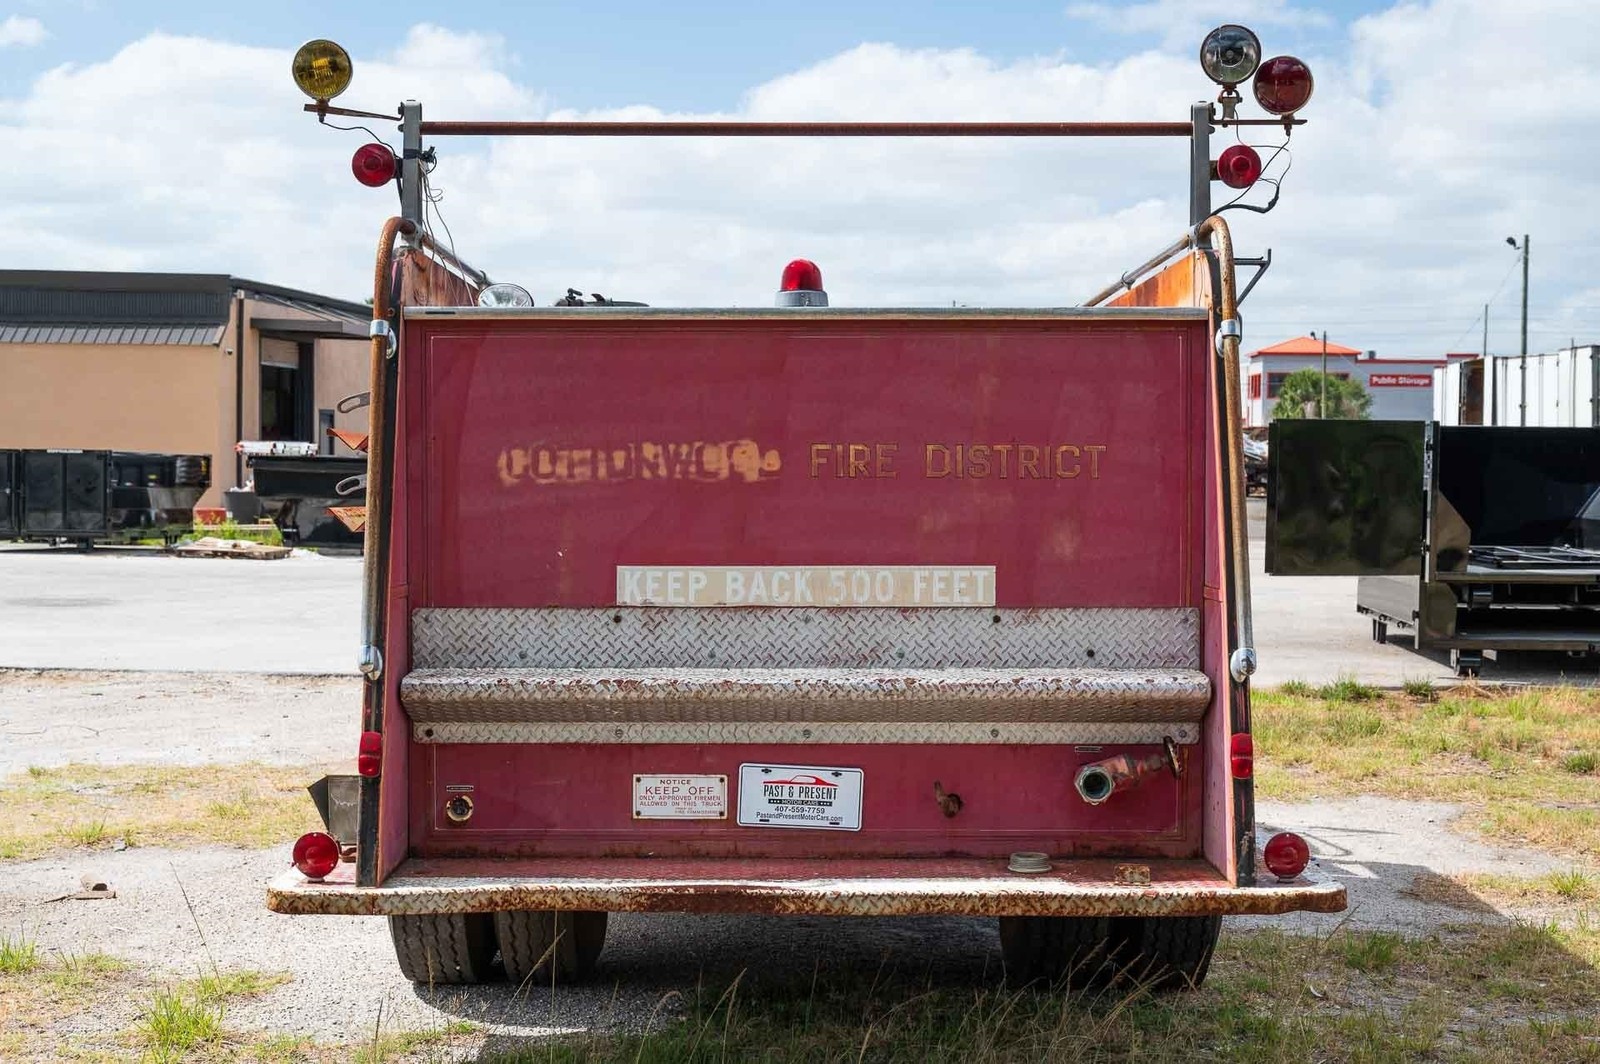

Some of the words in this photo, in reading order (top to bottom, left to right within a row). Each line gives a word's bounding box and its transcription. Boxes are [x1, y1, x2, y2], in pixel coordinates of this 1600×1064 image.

[810, 442, 899, 479] FIRE
[925, 443, 1108, 479] DISTRICT
[622, 570, 708, 603] KEEP
[726, 570, 813, 603] BACK
[827, 570, 894, 603] 500
[912, 570, 989, 603] FEET
[645, 786, 680, 795] KEEP
[688, 786, 714, 795] OFF
[763, 785, 784, 798] PAST
[788, 786, 794, 798] &
[799, 786, 838, 800] PRESENT
[774, 806, 826, 814] 407-559-7759
[756, 812, 844, 822] PastandPresentMotorCars.com
